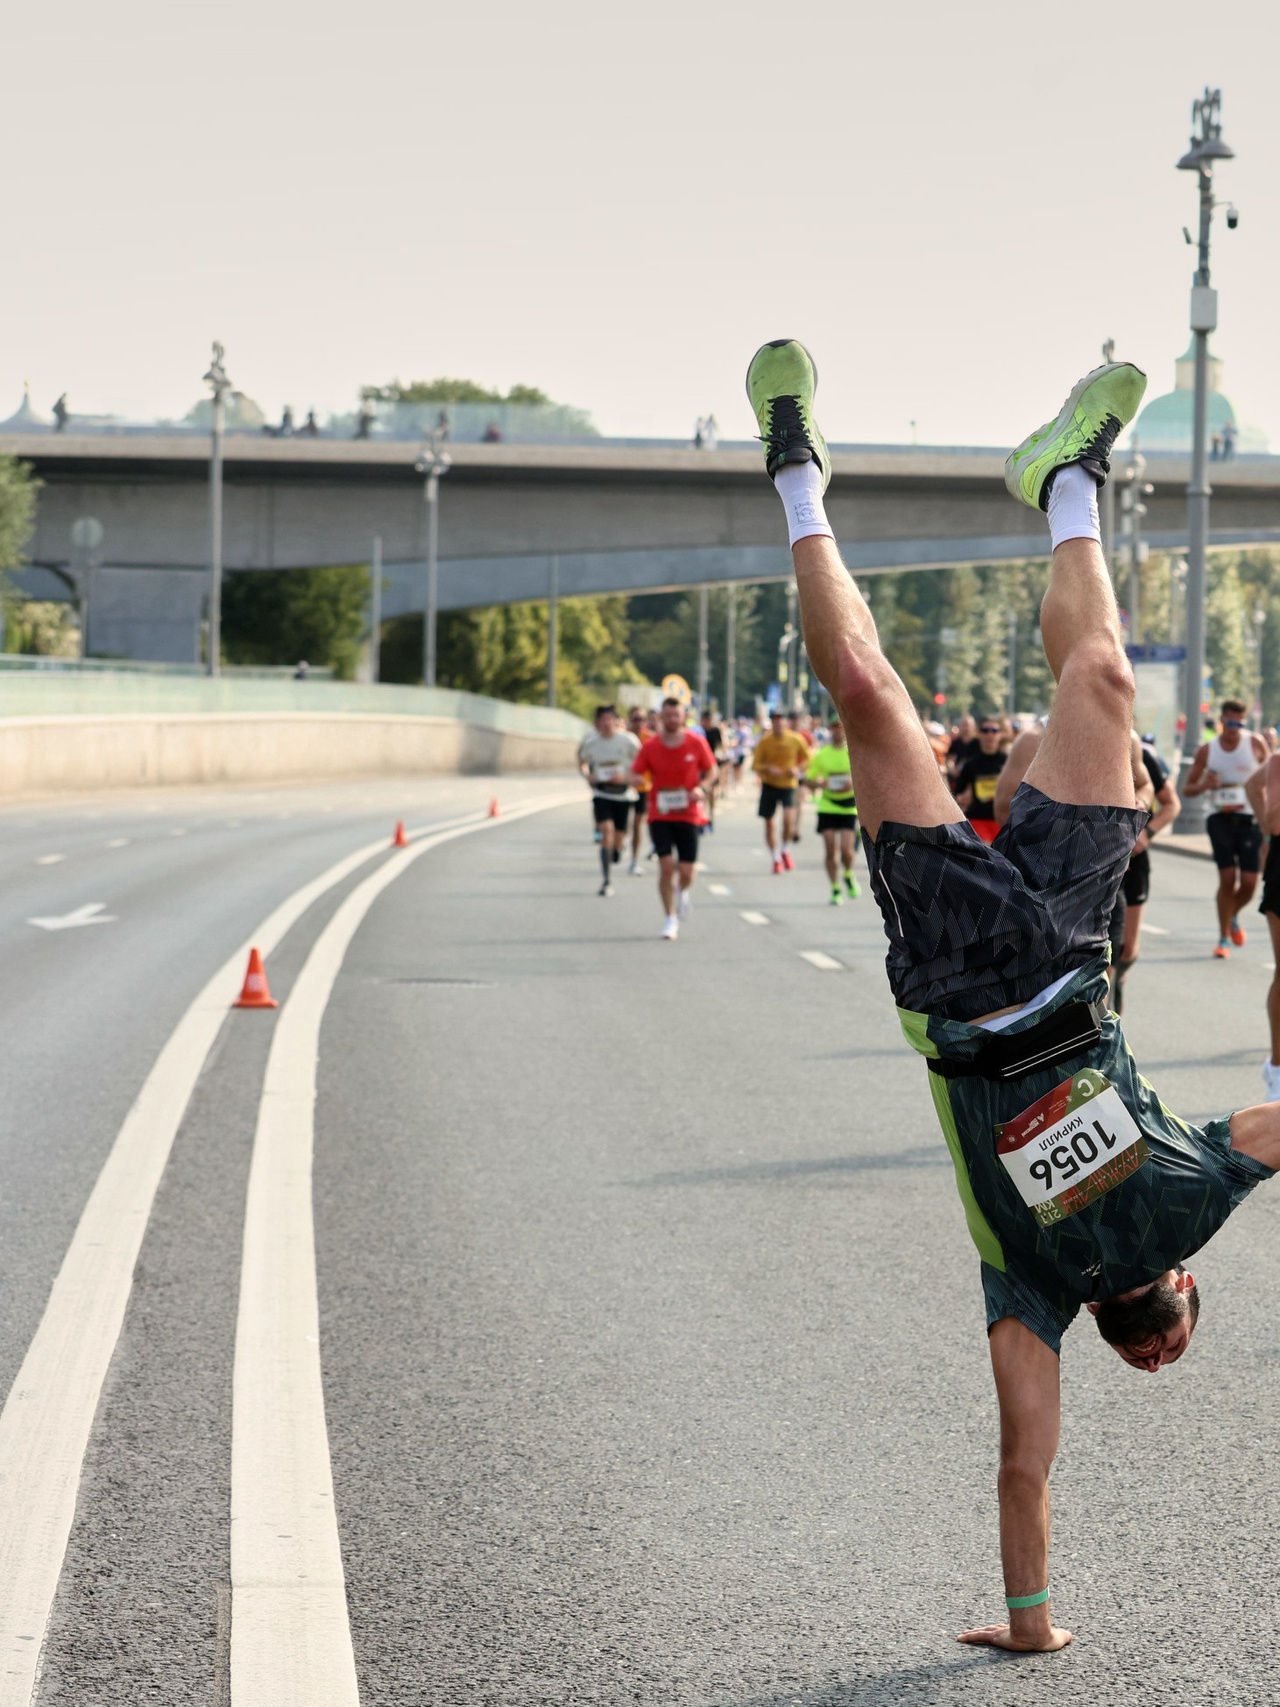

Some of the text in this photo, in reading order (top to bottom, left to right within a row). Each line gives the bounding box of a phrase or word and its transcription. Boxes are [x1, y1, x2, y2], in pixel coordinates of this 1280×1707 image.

[1077, 1078, 1095, 1097] C
[1038, 1116, 1084, 1151] КИРИЛЛ
[1029, 1120, 1117, 1191] 1056
